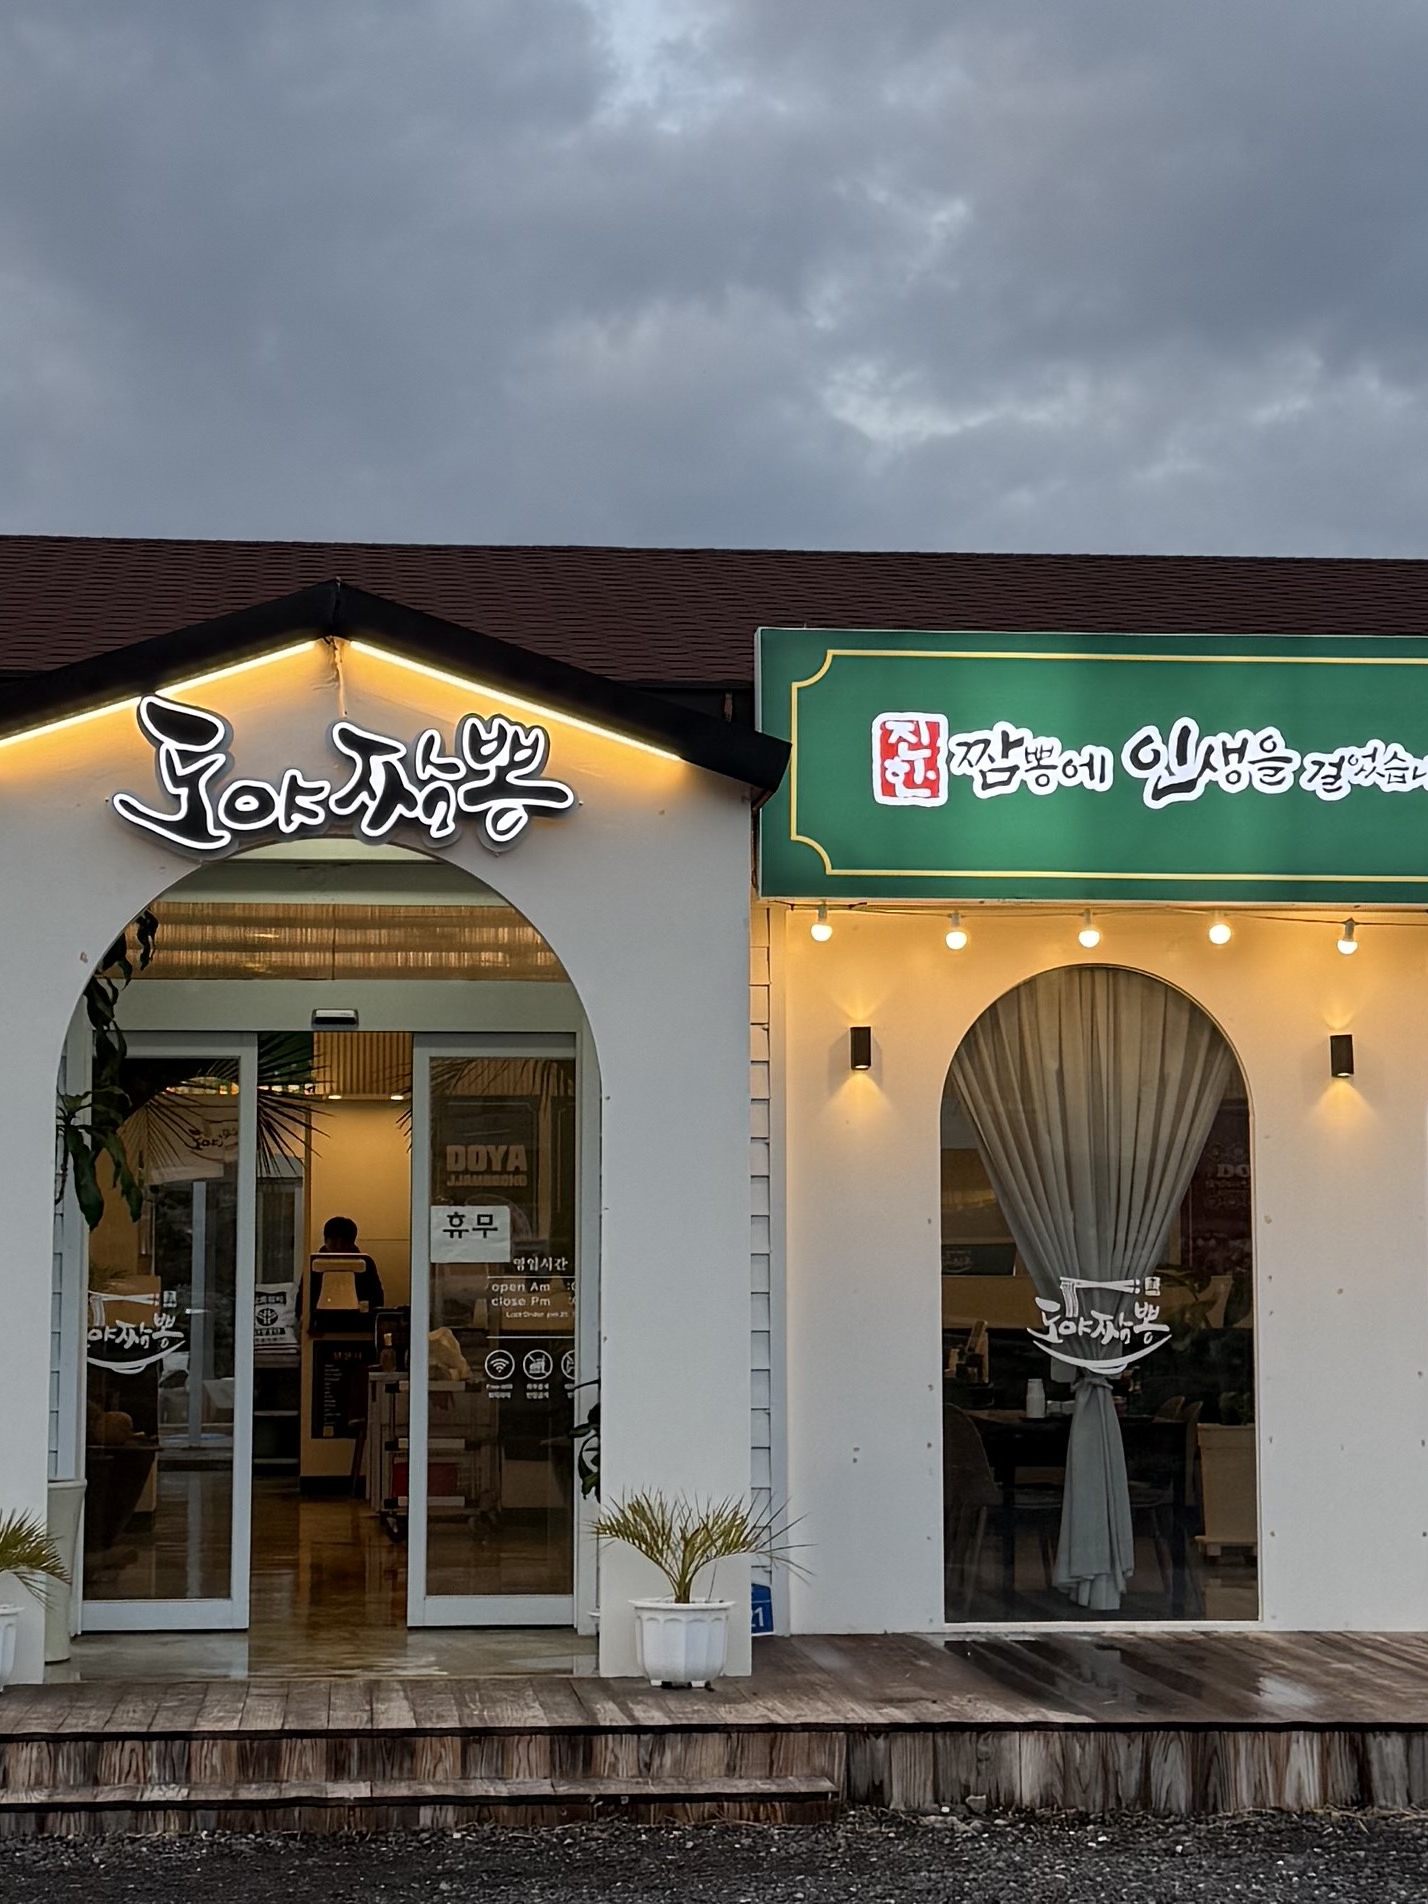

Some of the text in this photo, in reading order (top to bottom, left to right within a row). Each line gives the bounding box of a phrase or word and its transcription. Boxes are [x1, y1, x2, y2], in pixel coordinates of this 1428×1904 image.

[112, 696, 573, 850] 도야짬뽕
[877, 716, 943, 801] 진한
[955, 729, 1107, 792] 짬뽕에
[1128, 724, 1294, 802] 인생을
[446, 1144, 527, 1172] DOYA
[442, 1211, 499, 1239] 휴무
[513, 1256, 569, 1272] 영업시간
[491, 1282, 551, 1294] open Am
[491, 1296, 551, 1307] close Pm
[87, 1312, 184, 1350] 야짬뽕
[1026, 1296, 1171, 1345] 도야짬뽕
